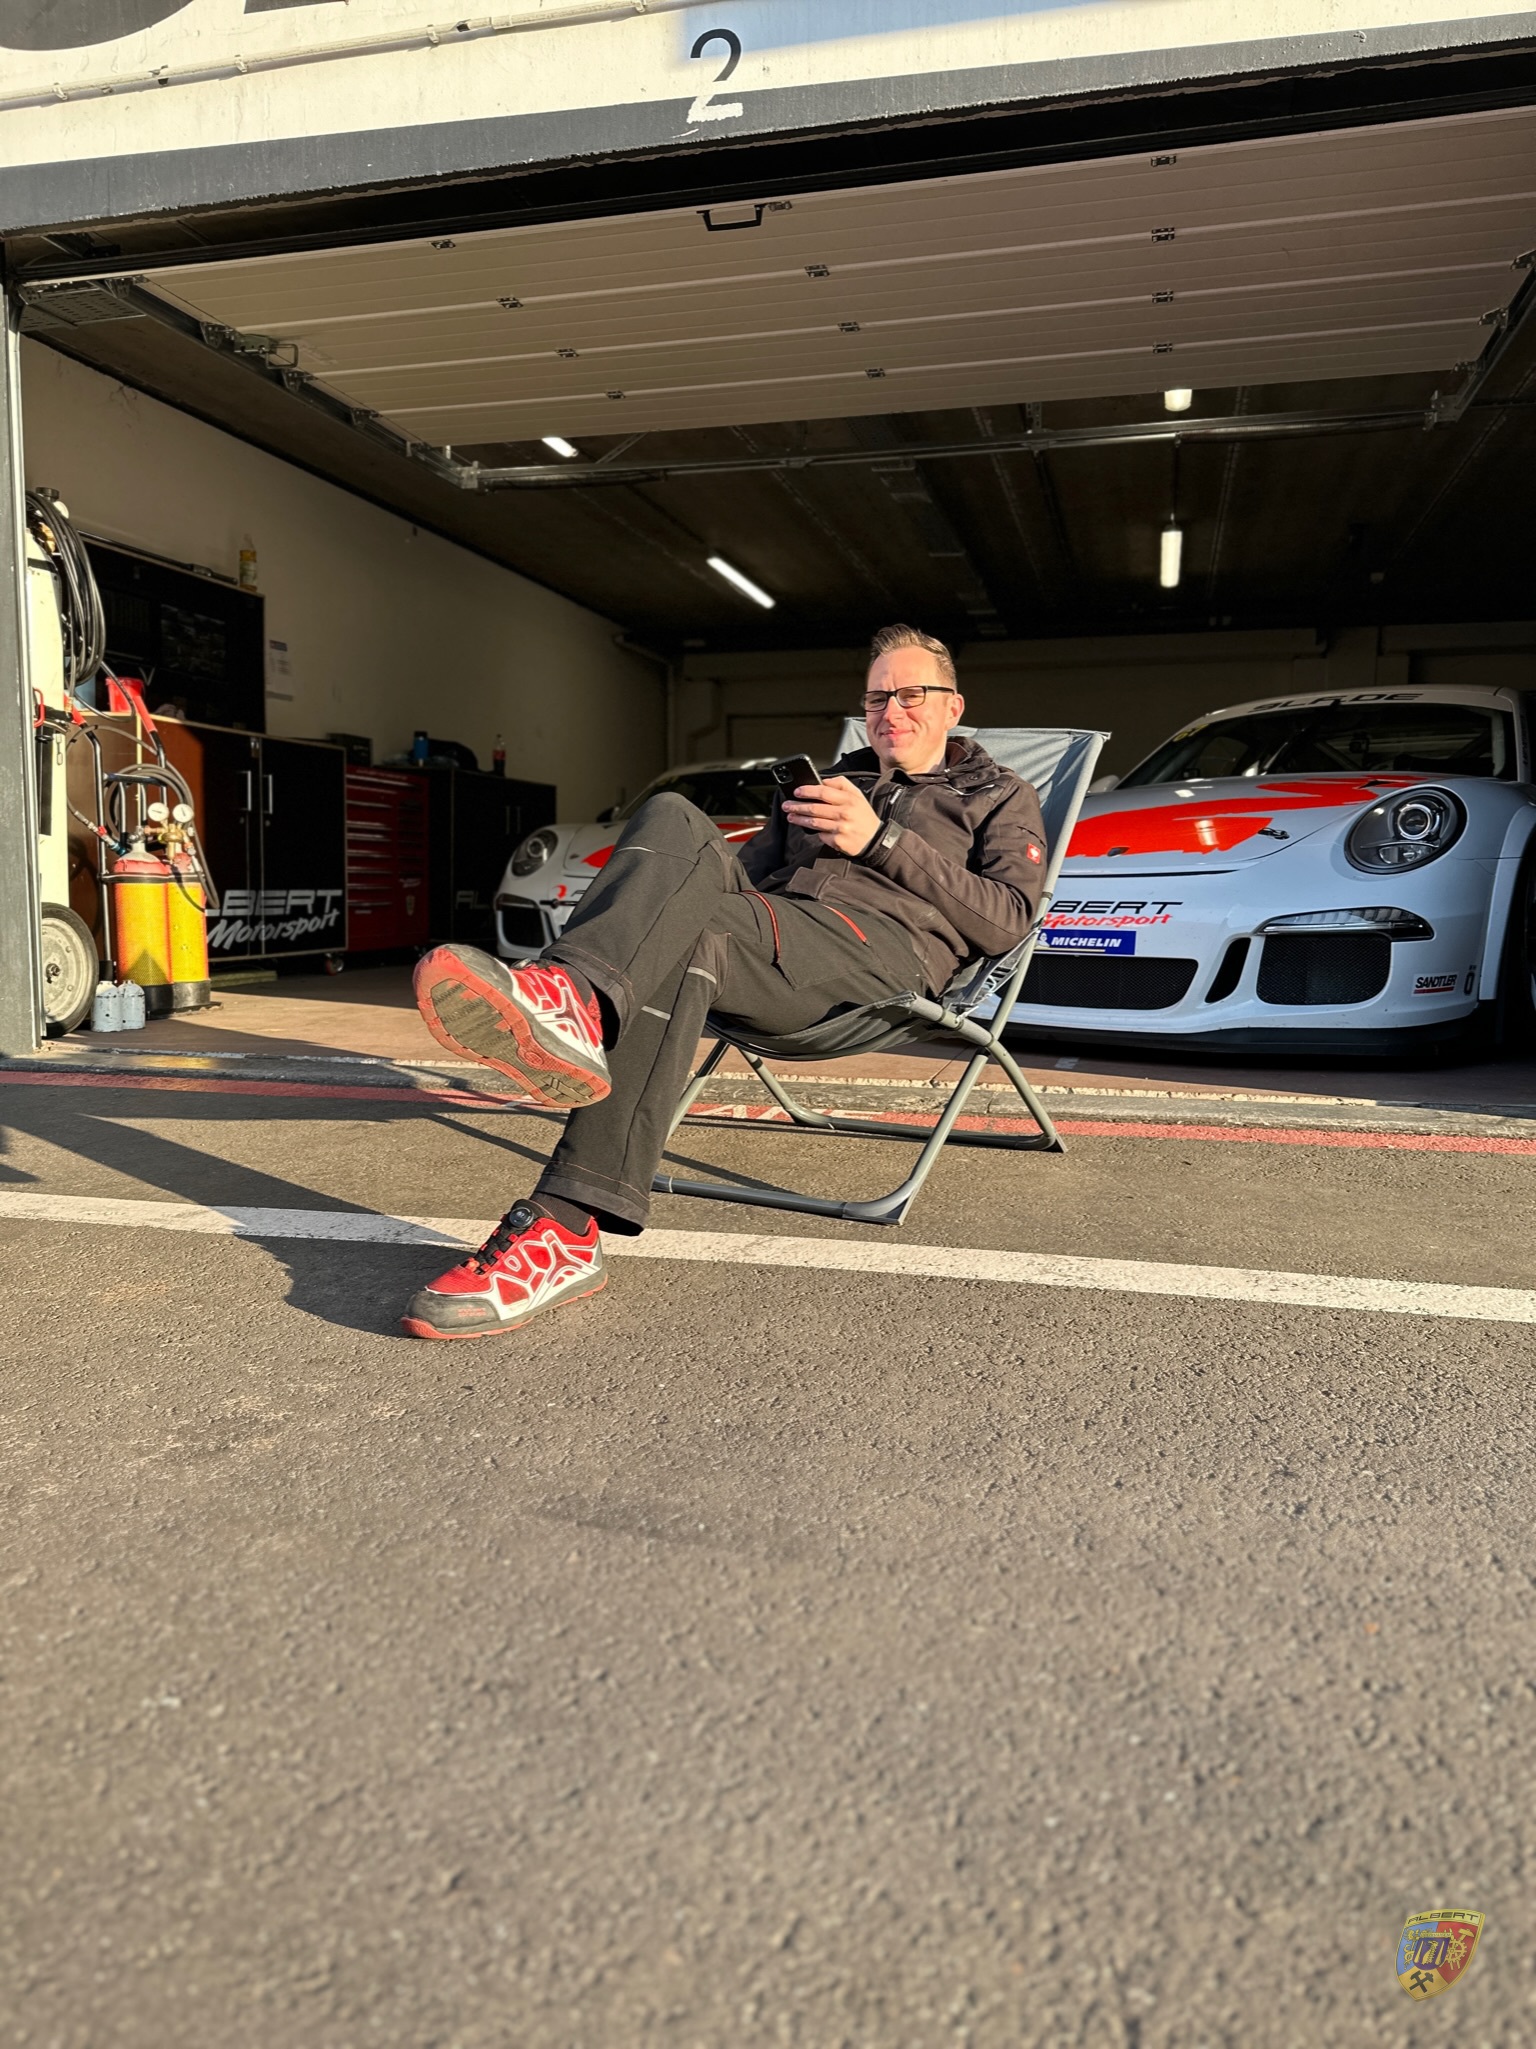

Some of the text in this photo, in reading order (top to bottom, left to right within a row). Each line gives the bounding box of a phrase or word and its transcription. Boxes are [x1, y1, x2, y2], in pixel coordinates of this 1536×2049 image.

[687, 28, 743, 124] 2
[205, 889, 342, 916] BERT
[1048, 900, 1183, 914] BERT
[1042, 913, 1172, 928] Motorsport
[207, 908, 340, 950] Motorsport
[1050, 936, 1122, 947] MICHELIN
[1415, 974, 1457, 988] SANDTLER
